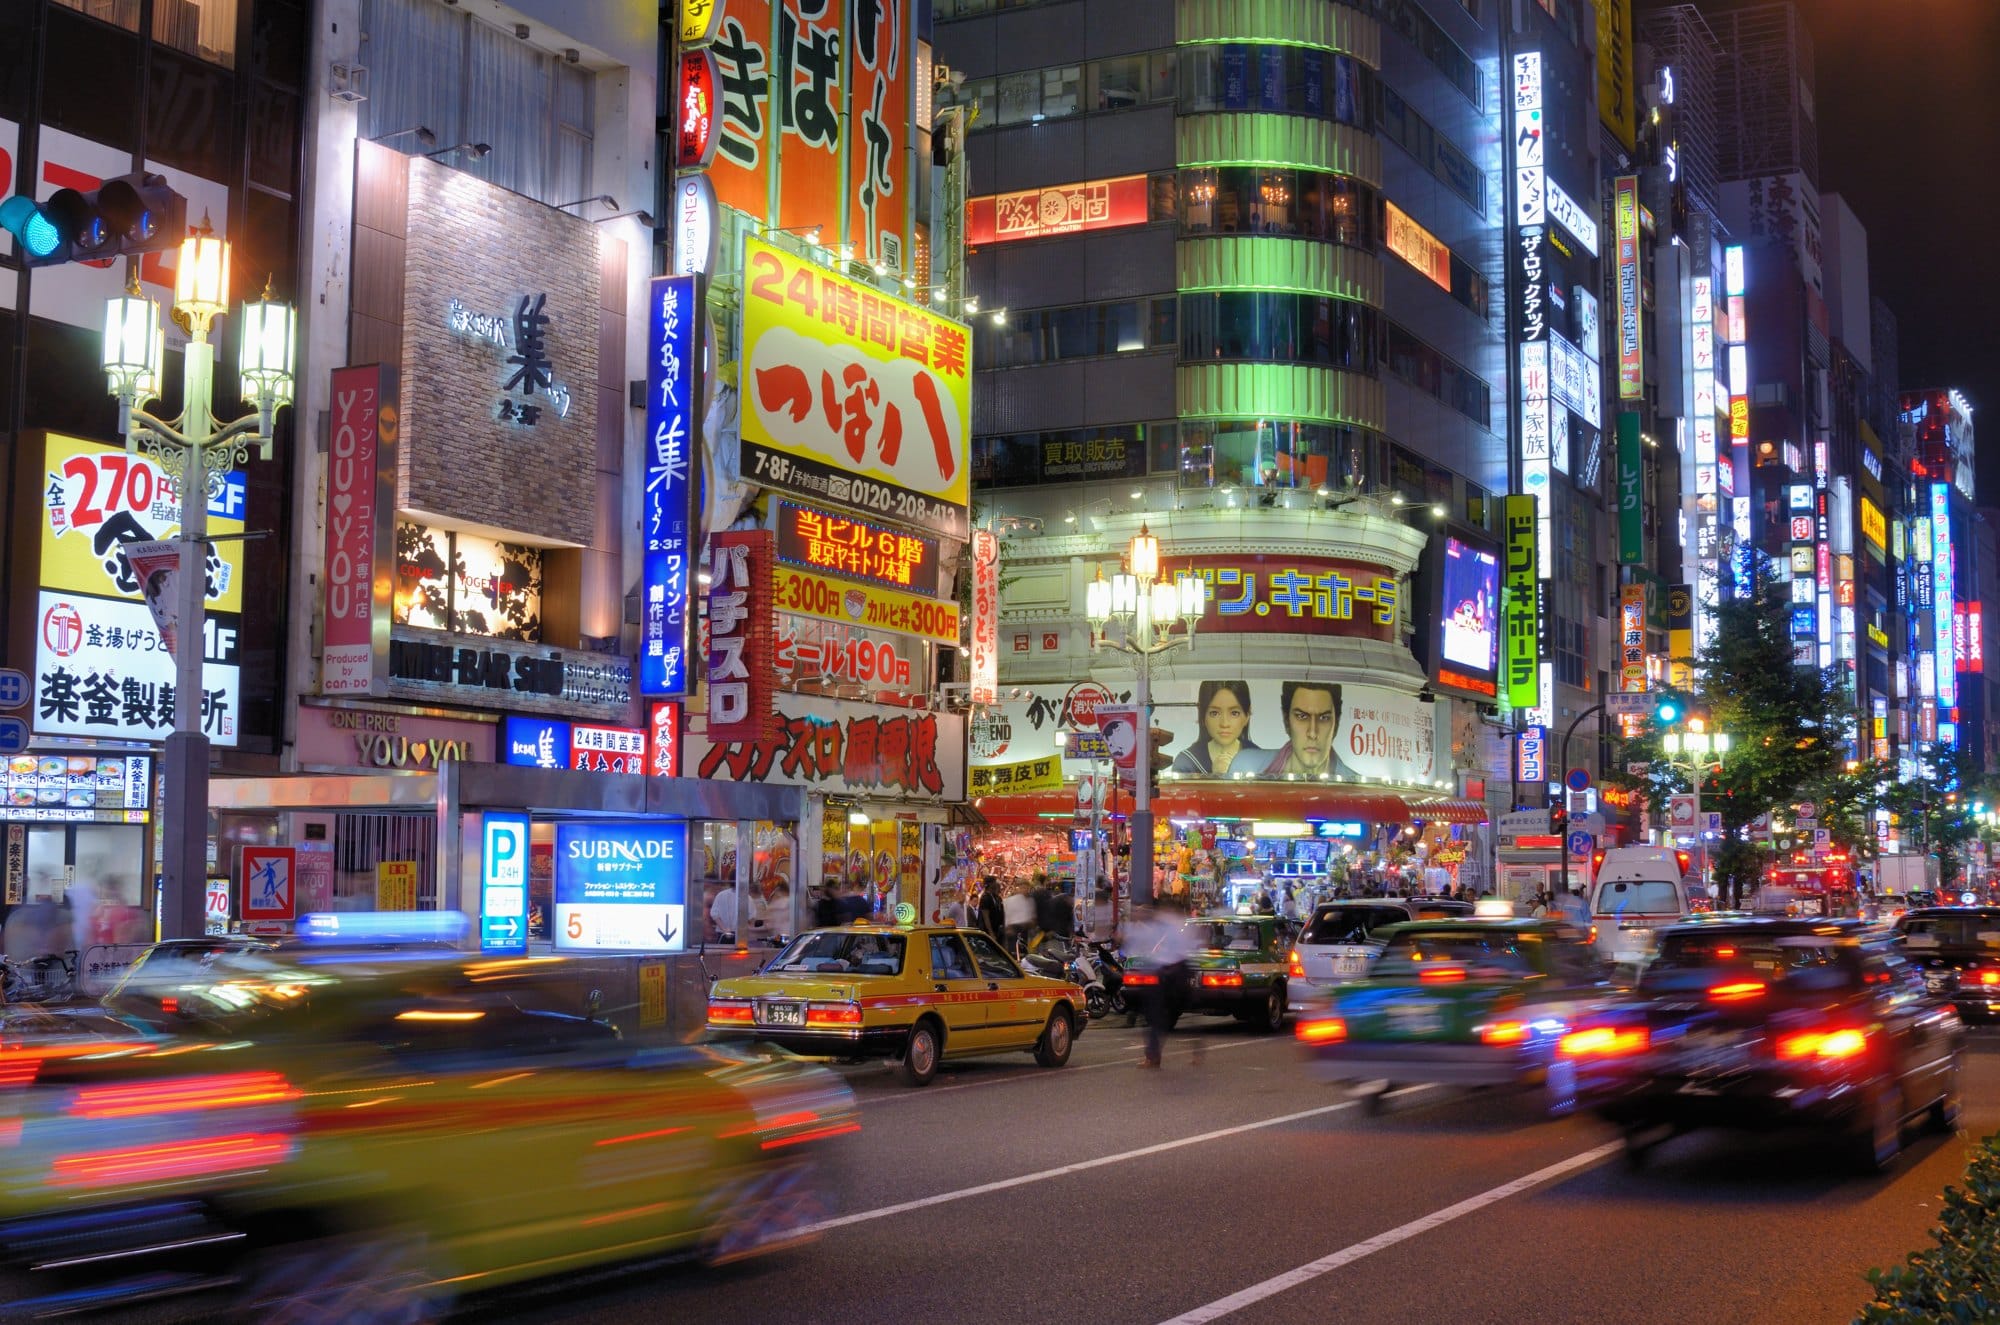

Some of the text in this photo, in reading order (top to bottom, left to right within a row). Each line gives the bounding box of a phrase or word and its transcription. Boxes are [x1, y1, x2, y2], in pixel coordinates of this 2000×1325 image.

[685, 25, 701, 37] 4F
[751, 251, 966, 379] 24時間営業
[755, 362, 955, 482] つぼ八
[1525, 370, 1545, 455] 北の家族
[648, 415, 688, 492] 集
[1044, 438, 1125, 466] 買取販売
[63, 456, 177, 528] 270円
[1623, 463, 1636, 510] レイク
[400, 565, 513, 595] COME TOGETHER
[667, 554, 681, 625] ワインと
[648, 585, 664, 657] 創作料理
[710, 543, 750, 725] パチスロ
[1970, 613, 1980, 660] SHIDAX
[326, 652, 368, 666] Produced
[1625, 630, 1642, 663] 麻雀
[342, 666, 353, 677] by
[333, 713, 365, 731] ONE
[990, 715, 1009, 724] OF THE
[990, 724, 1012, 741] END
[356, 733, 407, 767] YOU
[577, 730, 642, 752] 24時間営業
[655, 727, 673, 776] 養老
[972, 760, 1050, 788] 歌舞伎町
[1523, 740, 1540, 780] ダイコク
[492, 829, 516, 878] P
[569, 839, 674, 862] SUBNADE
[303, 874, 325, 889] YOU
[597, 863, 643, 872] 新宿サブナード
[207, 890, 229, 913] 70
[567, 912, 583, 939] 5
